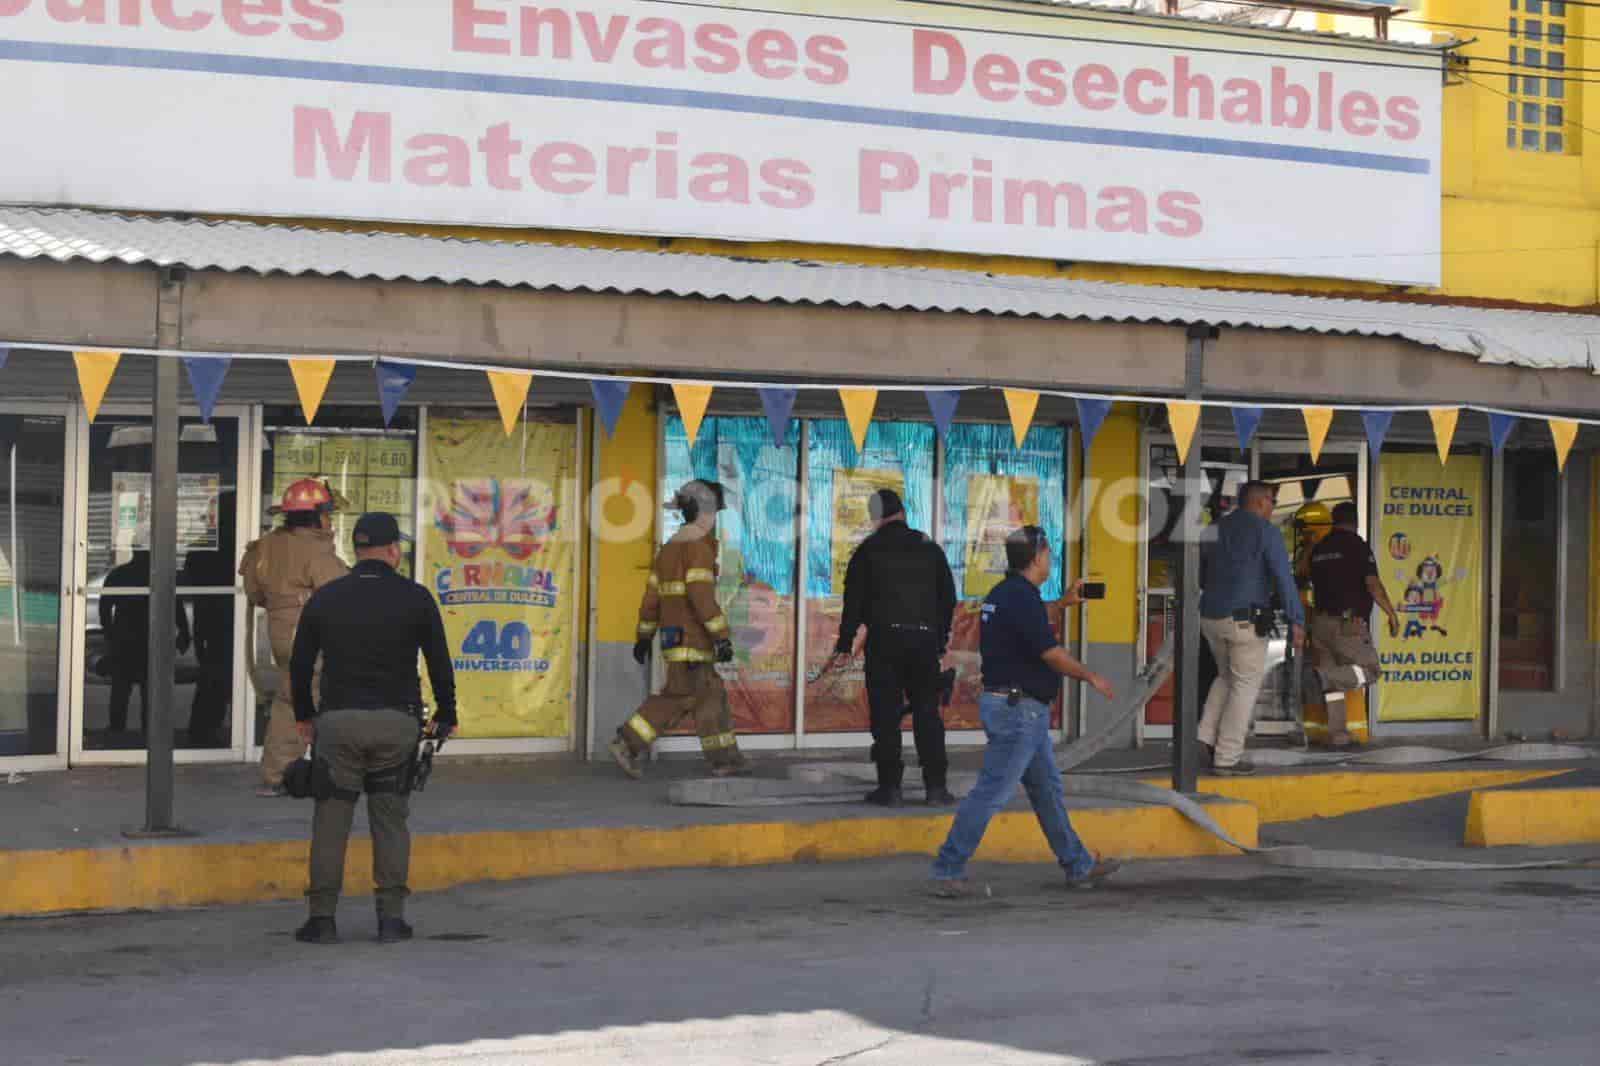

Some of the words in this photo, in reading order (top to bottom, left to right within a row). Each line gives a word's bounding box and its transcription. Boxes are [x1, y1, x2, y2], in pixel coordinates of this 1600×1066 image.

[0, 0, 345, 41] ces
[453, 0, 848, 85] Envases
[912, 28, 1420, 139] Desechables
[293, 105, 813, 209] Materias
[859, 148, 1203, 238] Primas
[1390, 486, 1471, 499] CENTRAL
[1384, 503, 1406, 515] DE
[461, 619, 531, 659] 40
[453, 658, 550, 670] NIVERSARIO
[1380, 651, 1416, 664] UNA
[1421, 651, 1473, 664] DULCE
[1382, 667, 1473, 681] TRADICIÓN
